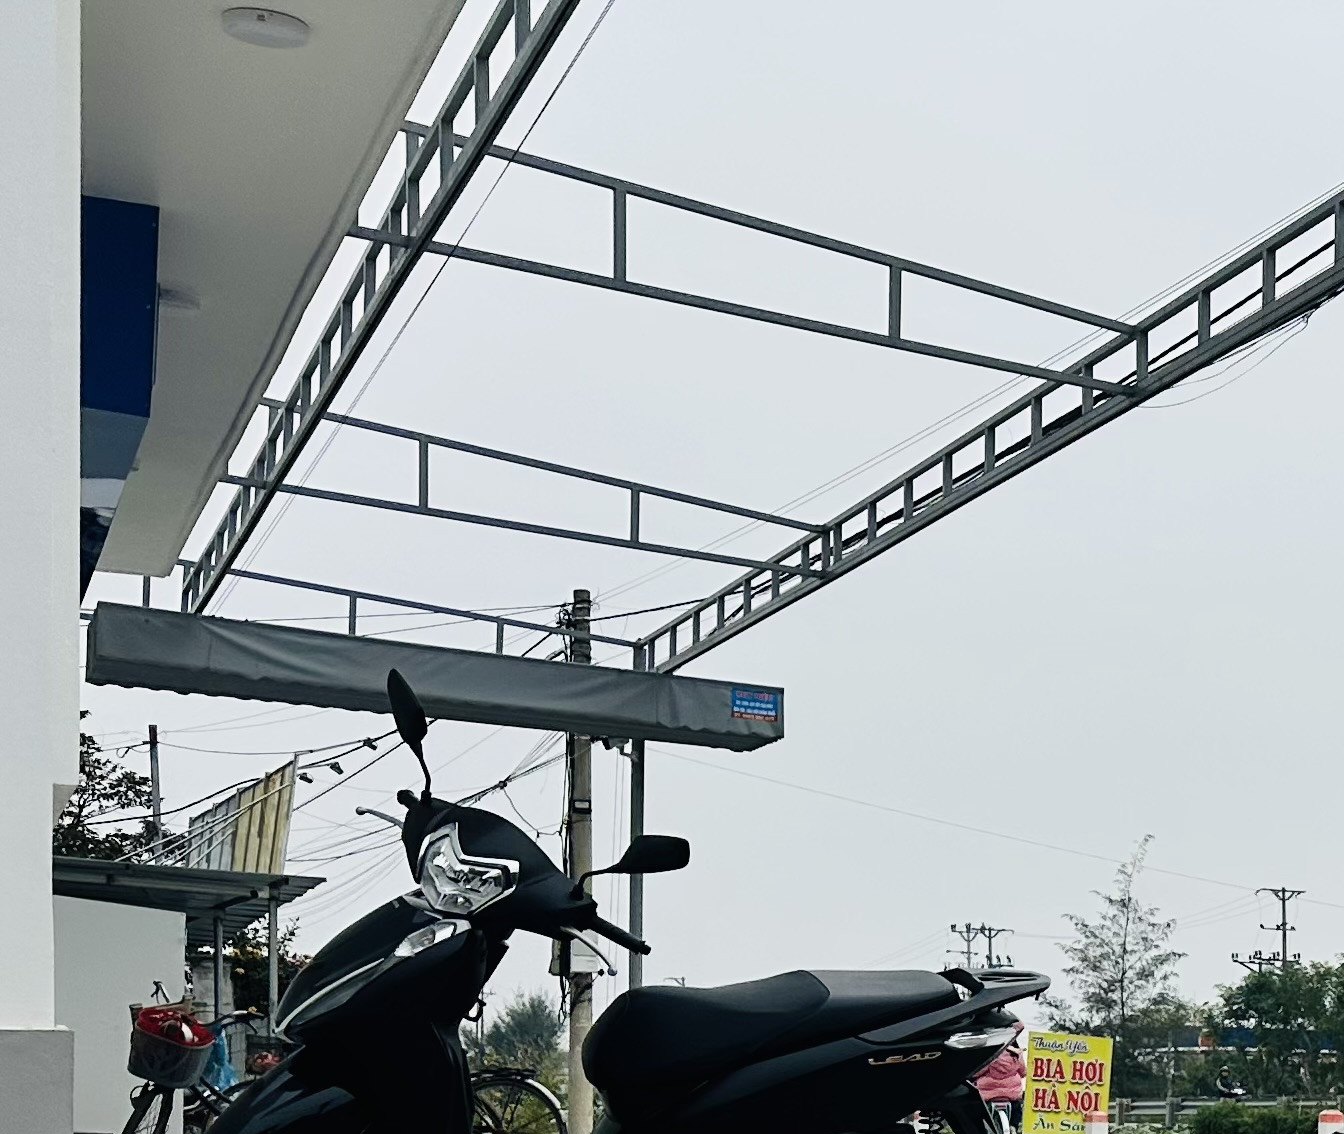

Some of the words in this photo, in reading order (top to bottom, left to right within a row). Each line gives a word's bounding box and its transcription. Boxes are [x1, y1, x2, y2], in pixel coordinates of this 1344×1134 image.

[868, 1051, 942, 1065] LEAD
[1032, 1057, 1066, 1080] BIA
[1070, 1058, 1105, 1083] HƠI
[1033, 1083, 1061, 1110] HÀ
[1066, 1085, 1101, 1115] NỘI
[1033, 1114, 1055, 1130] Ăn
